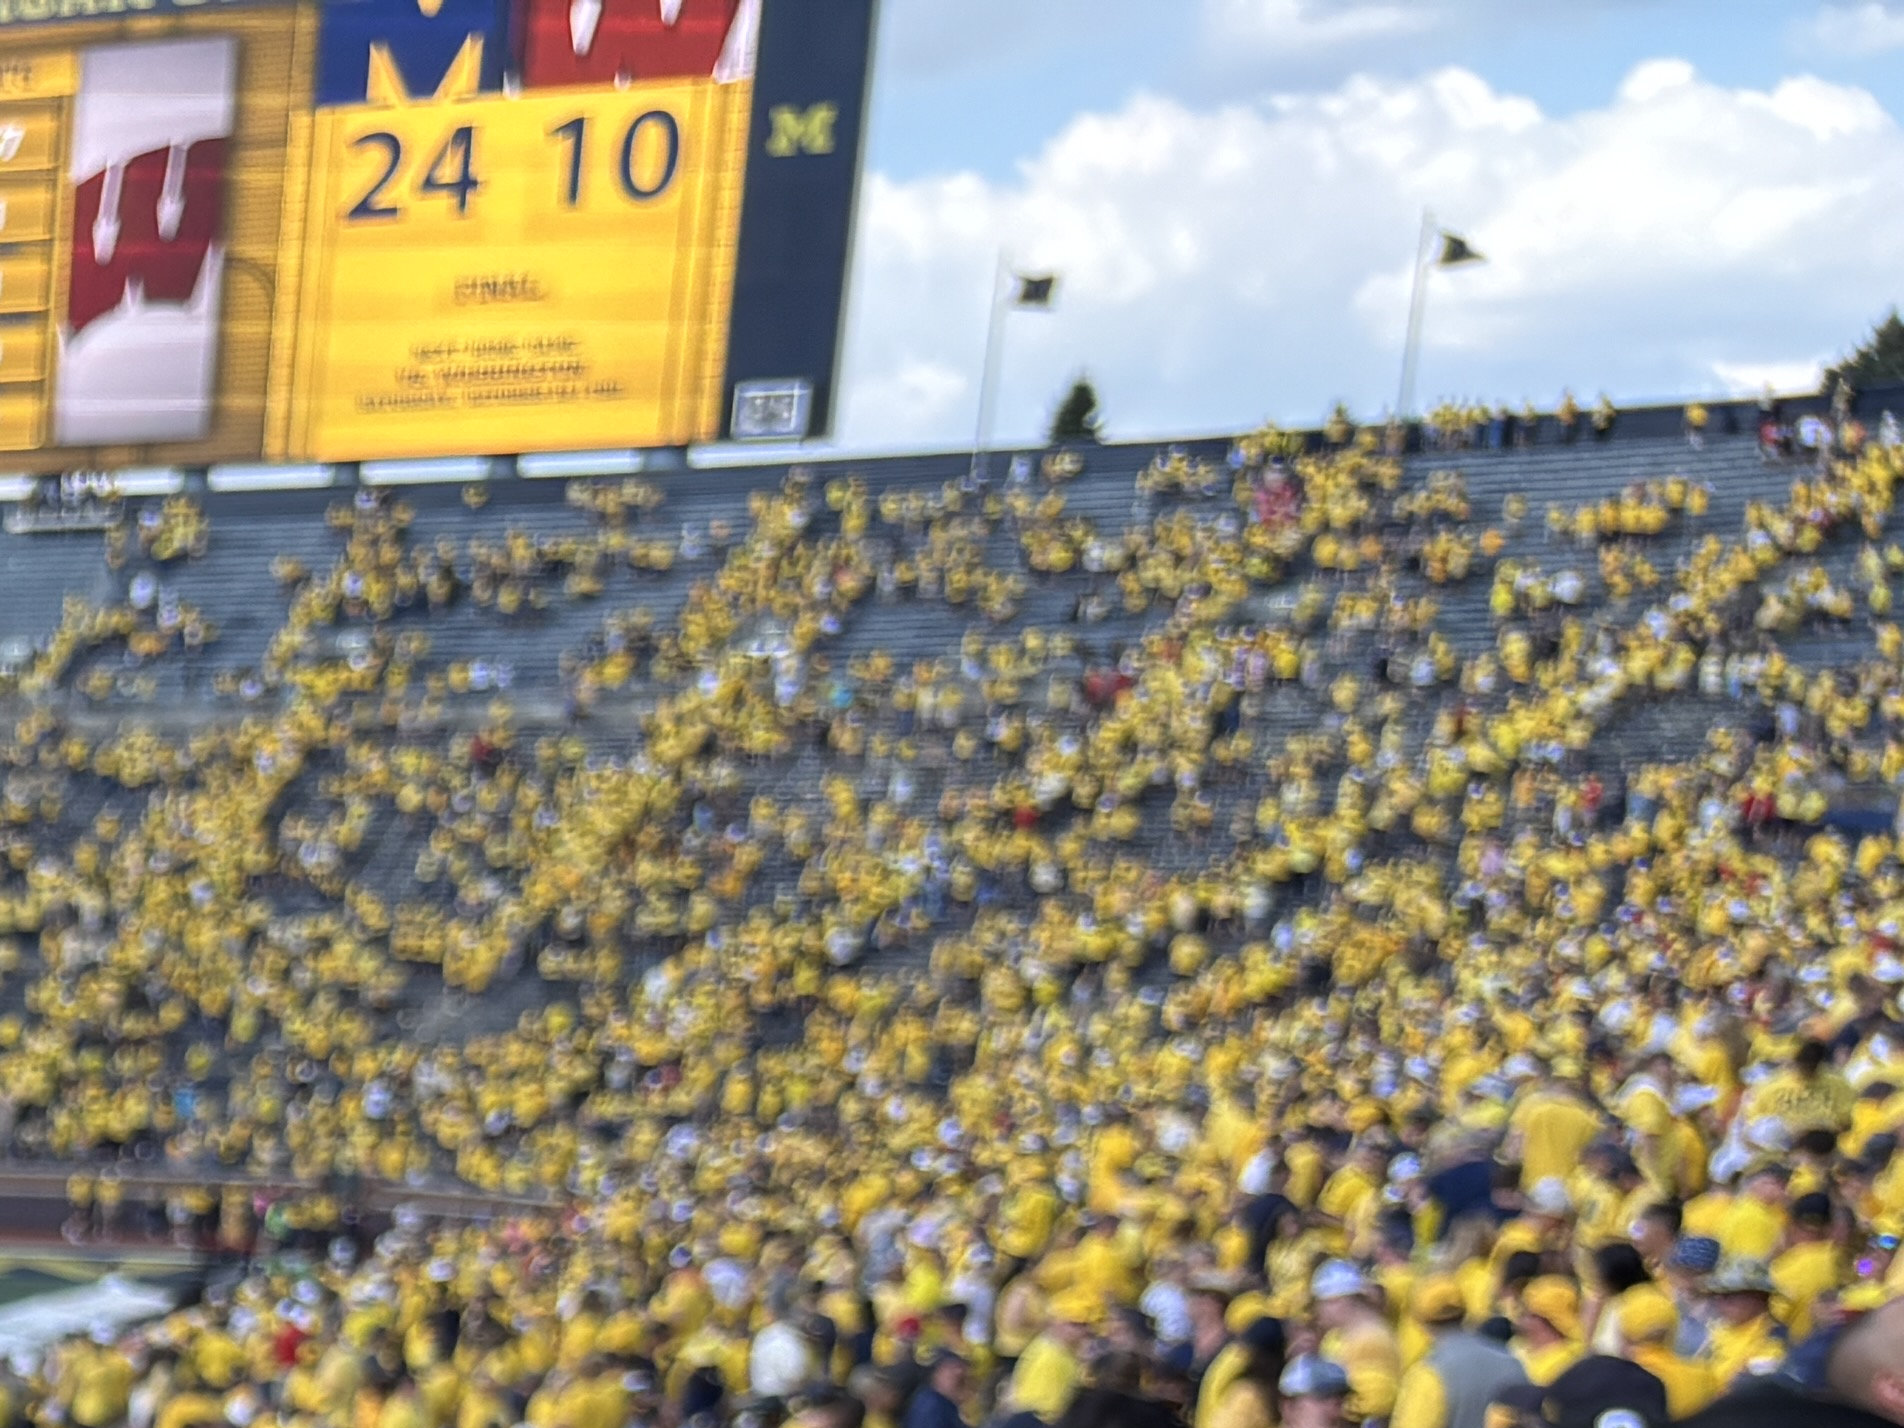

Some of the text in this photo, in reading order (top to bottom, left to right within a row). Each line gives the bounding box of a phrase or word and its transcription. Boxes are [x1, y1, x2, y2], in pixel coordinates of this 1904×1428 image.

[348, 108, 679, 220] 24 10
[766, 104, 837, 157] M
